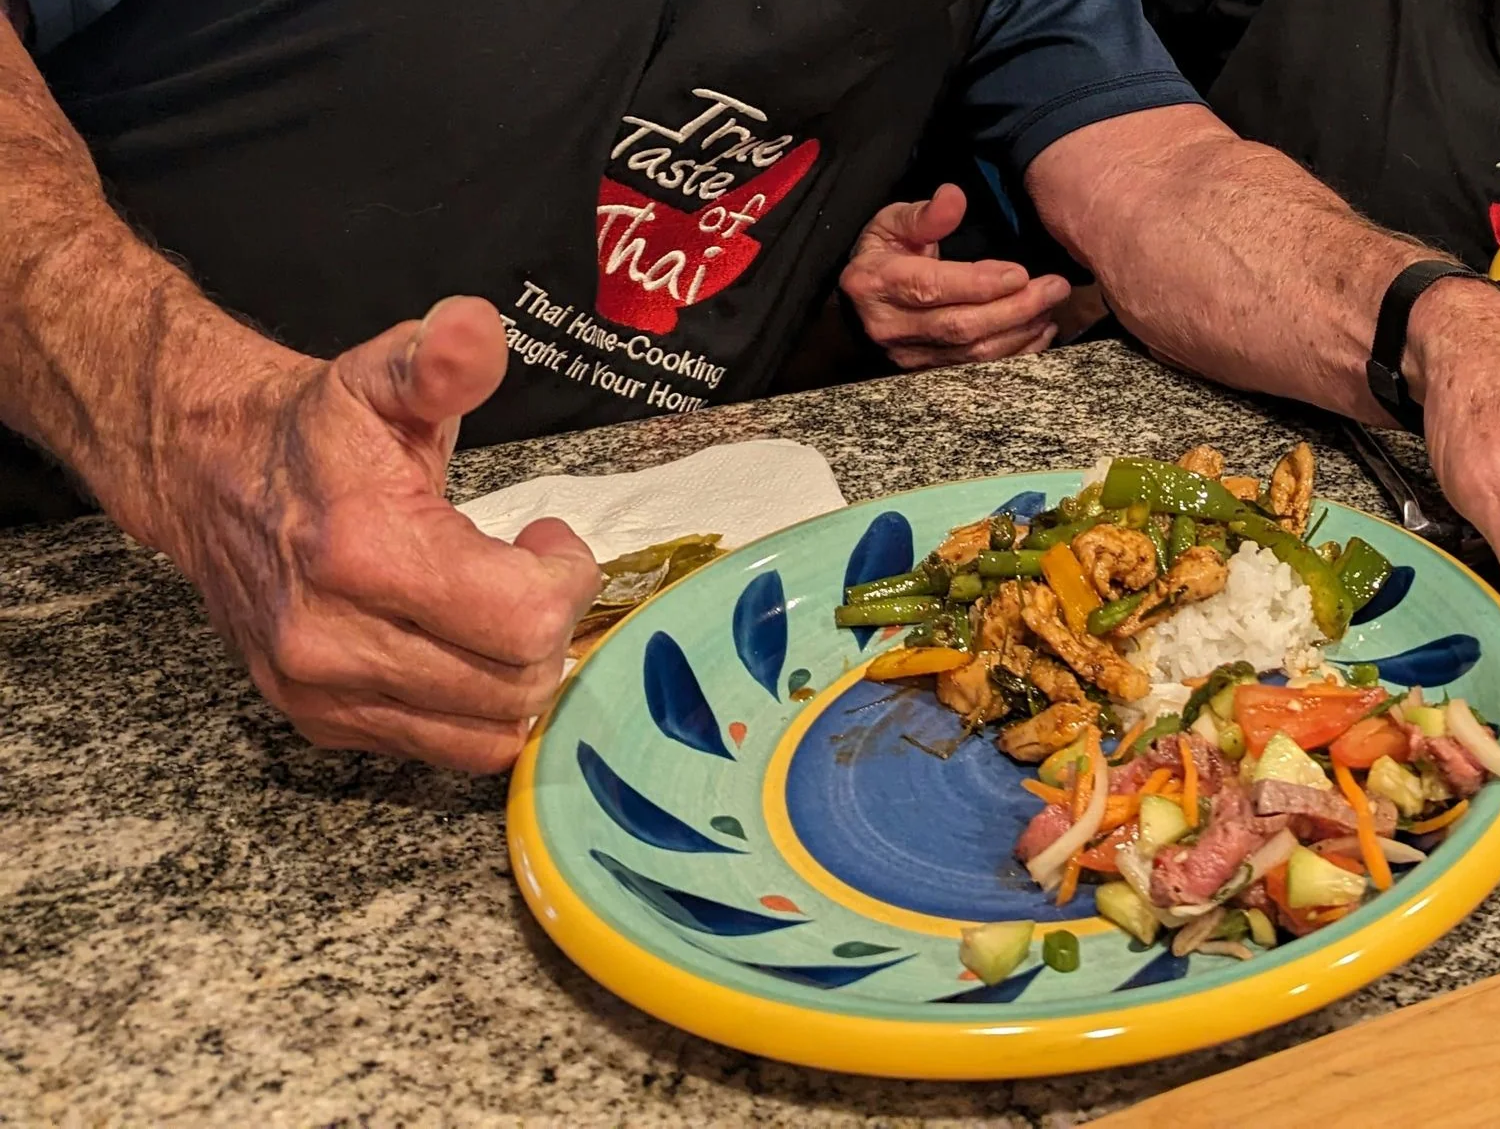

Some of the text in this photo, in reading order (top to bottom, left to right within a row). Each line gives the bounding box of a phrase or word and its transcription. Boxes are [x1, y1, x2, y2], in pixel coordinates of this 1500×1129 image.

[611, 116, 736, 200] Taste
[692, 88, 794, 168] True
[597, 203, 723, 306] Thai
[699, 193, 767, 239] of
[515, 280, 728, 390] Thai Home-Cooking
[565, 354, 590, 381] in
[590, 361, 648, 400] Your
